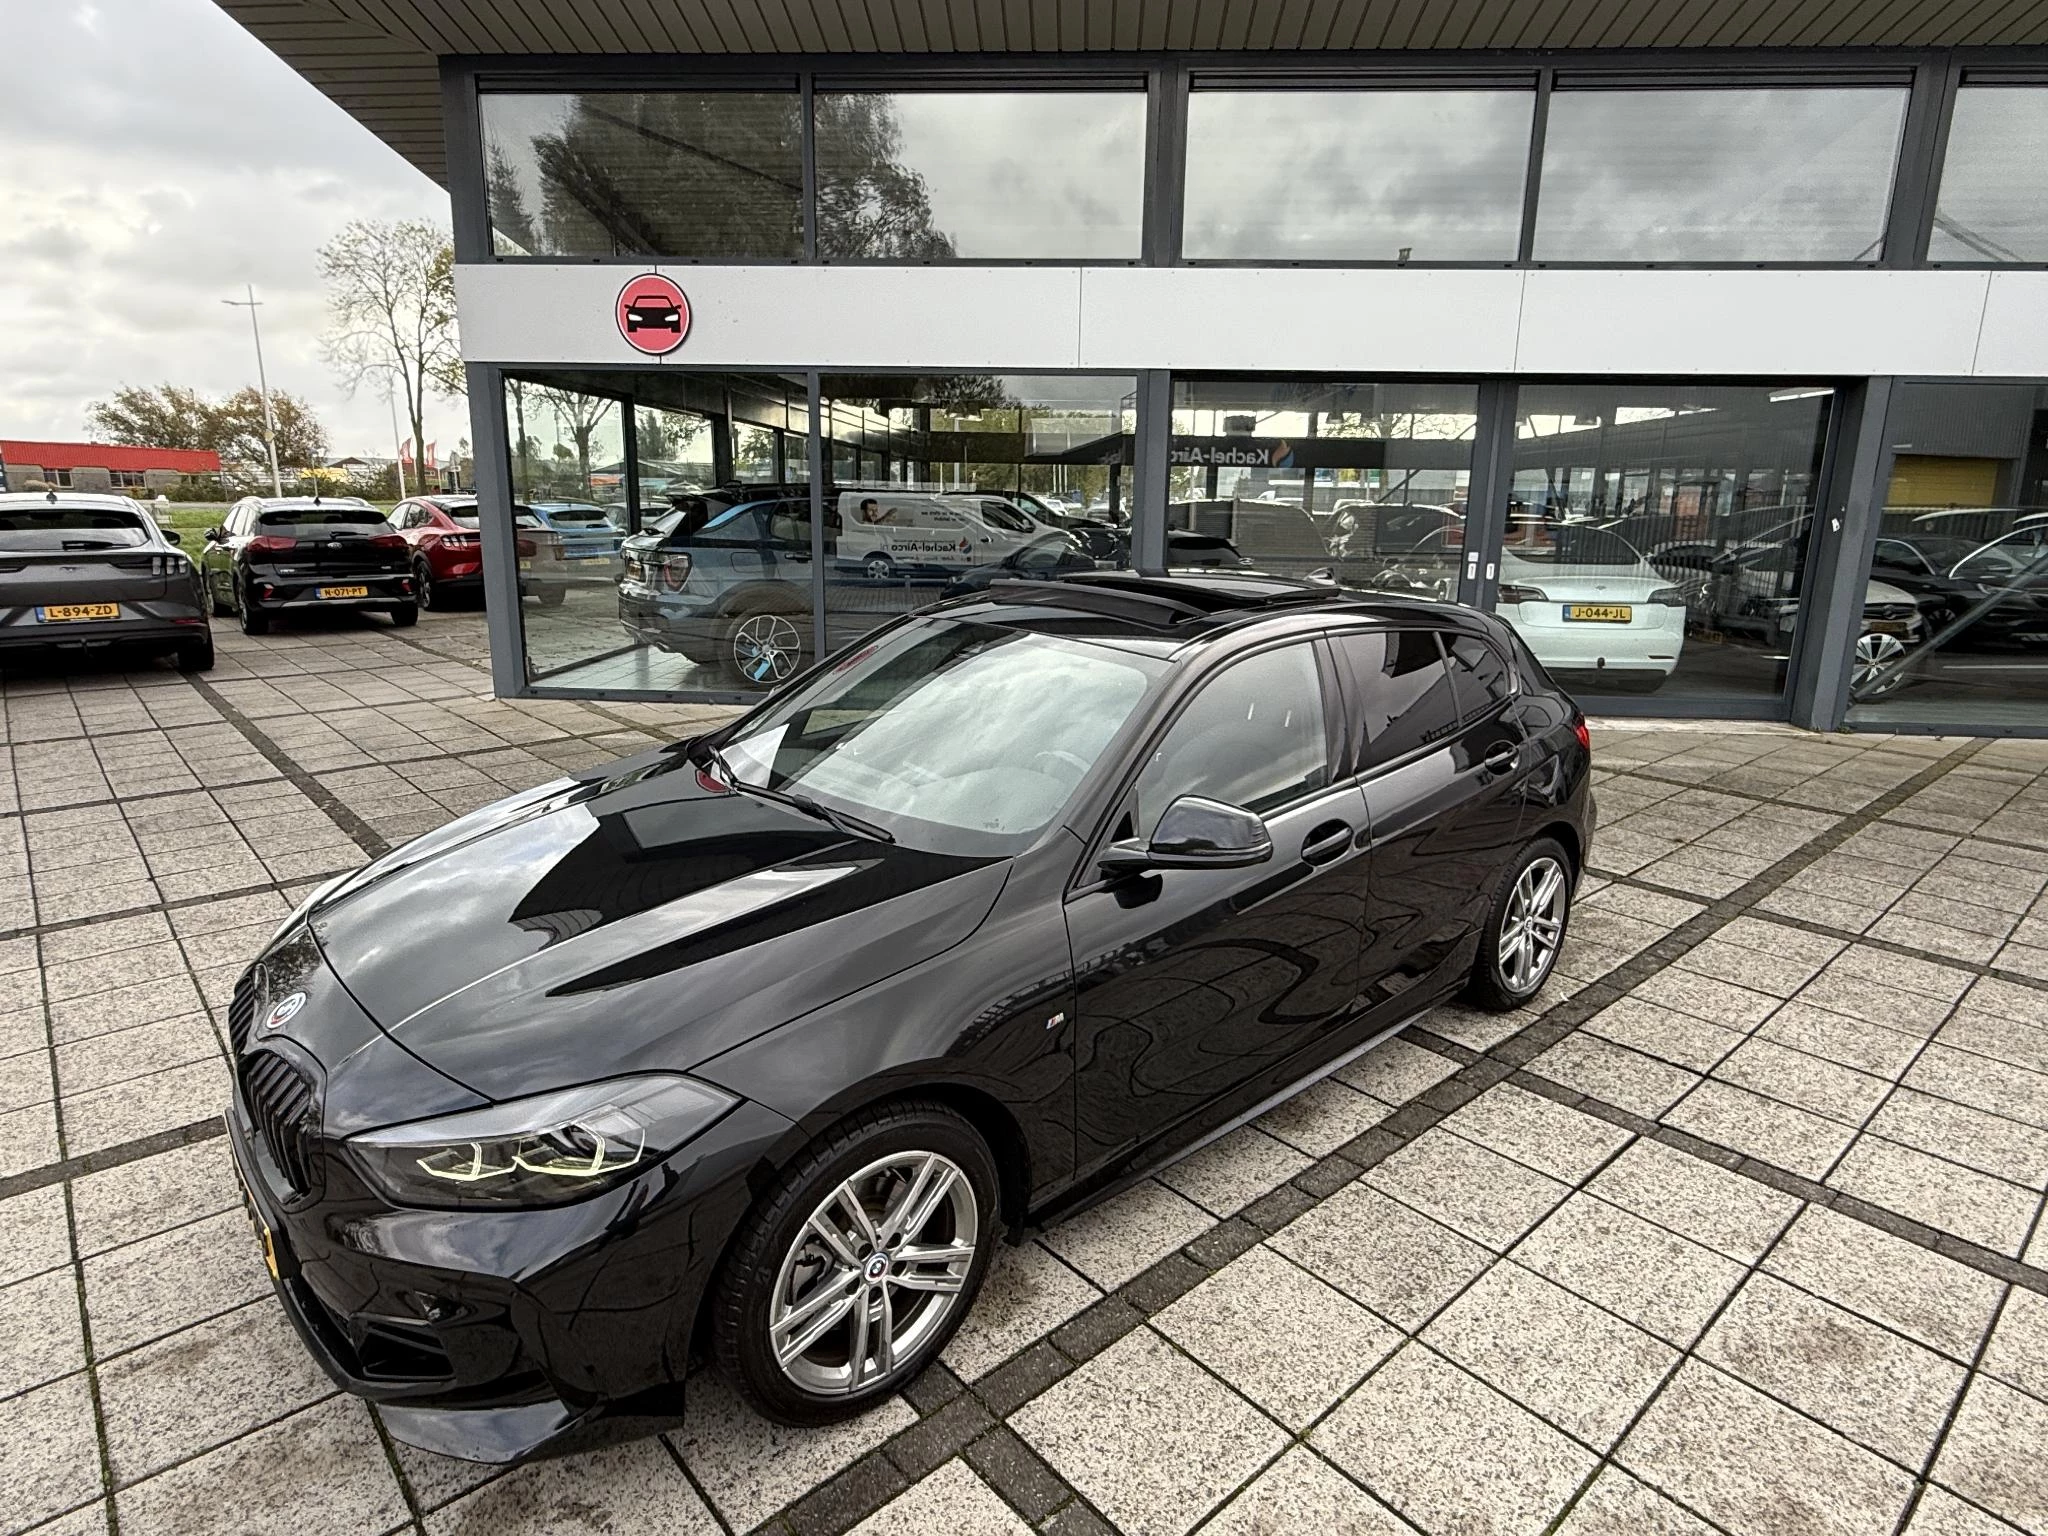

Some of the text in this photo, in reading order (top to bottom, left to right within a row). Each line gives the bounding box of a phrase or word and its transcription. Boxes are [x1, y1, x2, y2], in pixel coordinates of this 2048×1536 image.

[324, 587, 363, 597] N-071-PT
[49, 605, 113, 618] L-894-ZD
[1575, 607, 1626, 619] J-044-JL
